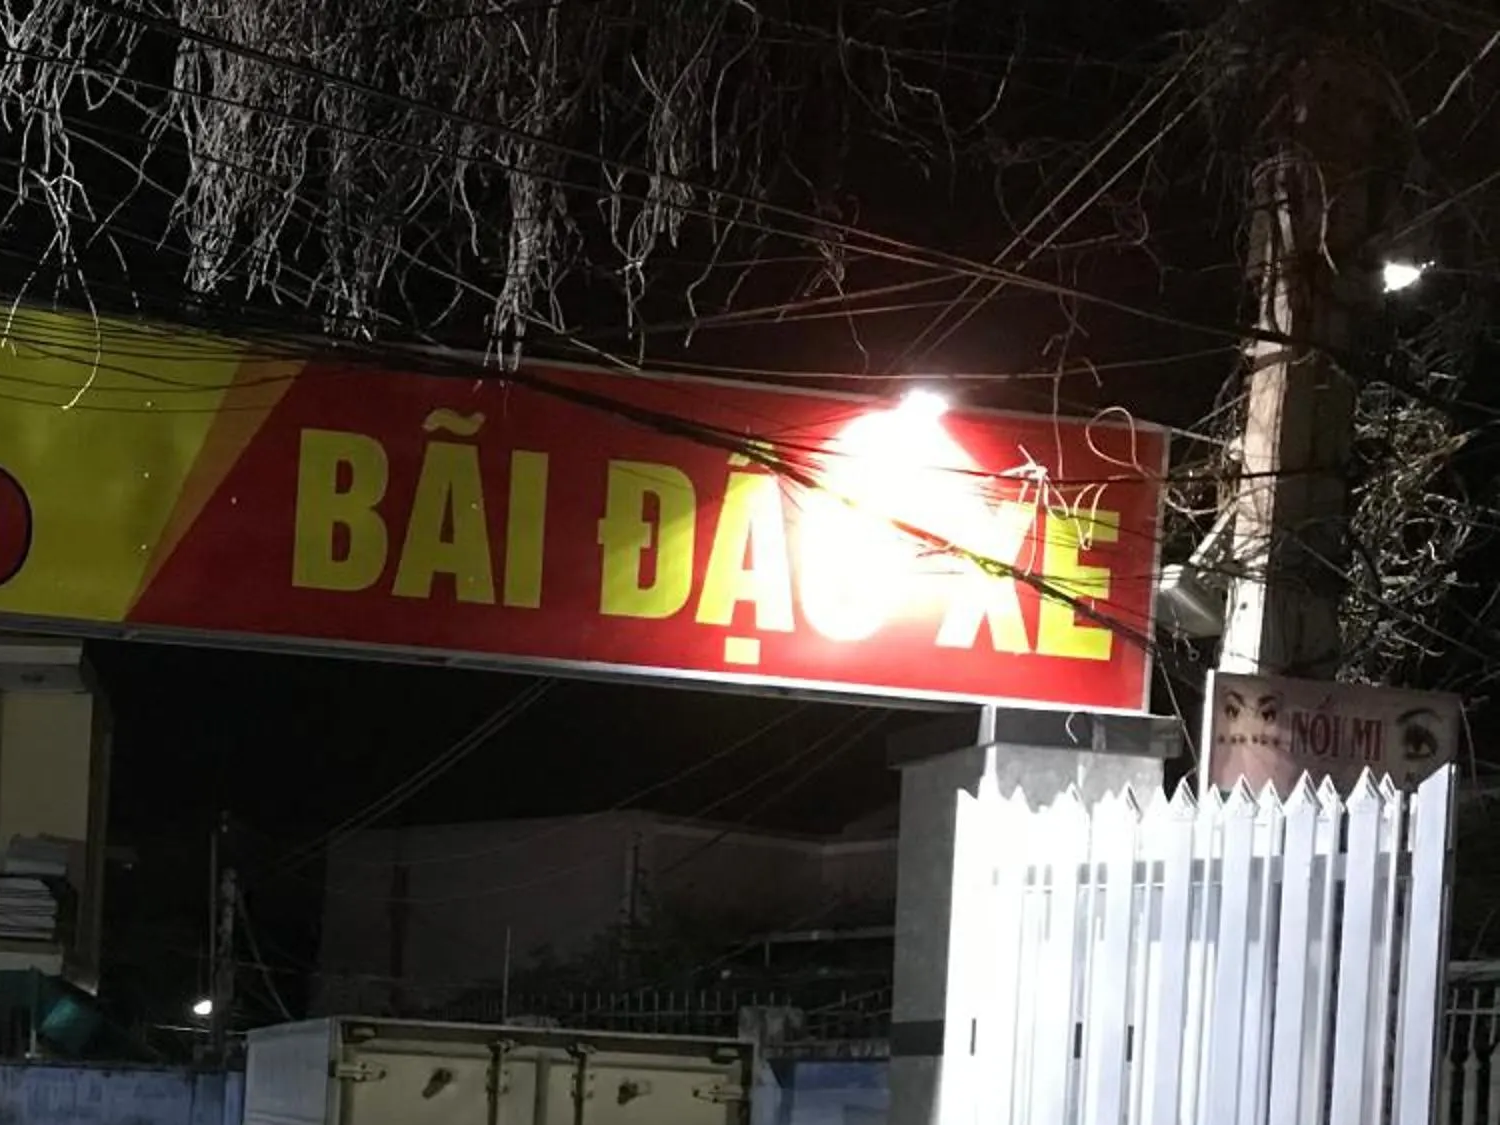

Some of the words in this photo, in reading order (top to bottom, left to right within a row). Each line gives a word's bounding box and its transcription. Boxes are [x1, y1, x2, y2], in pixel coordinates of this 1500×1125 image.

[290, 408, 549, 610] BÃI
[934, 493, 1120, 662] XE
[1351, 717, 1382, 762] MI
